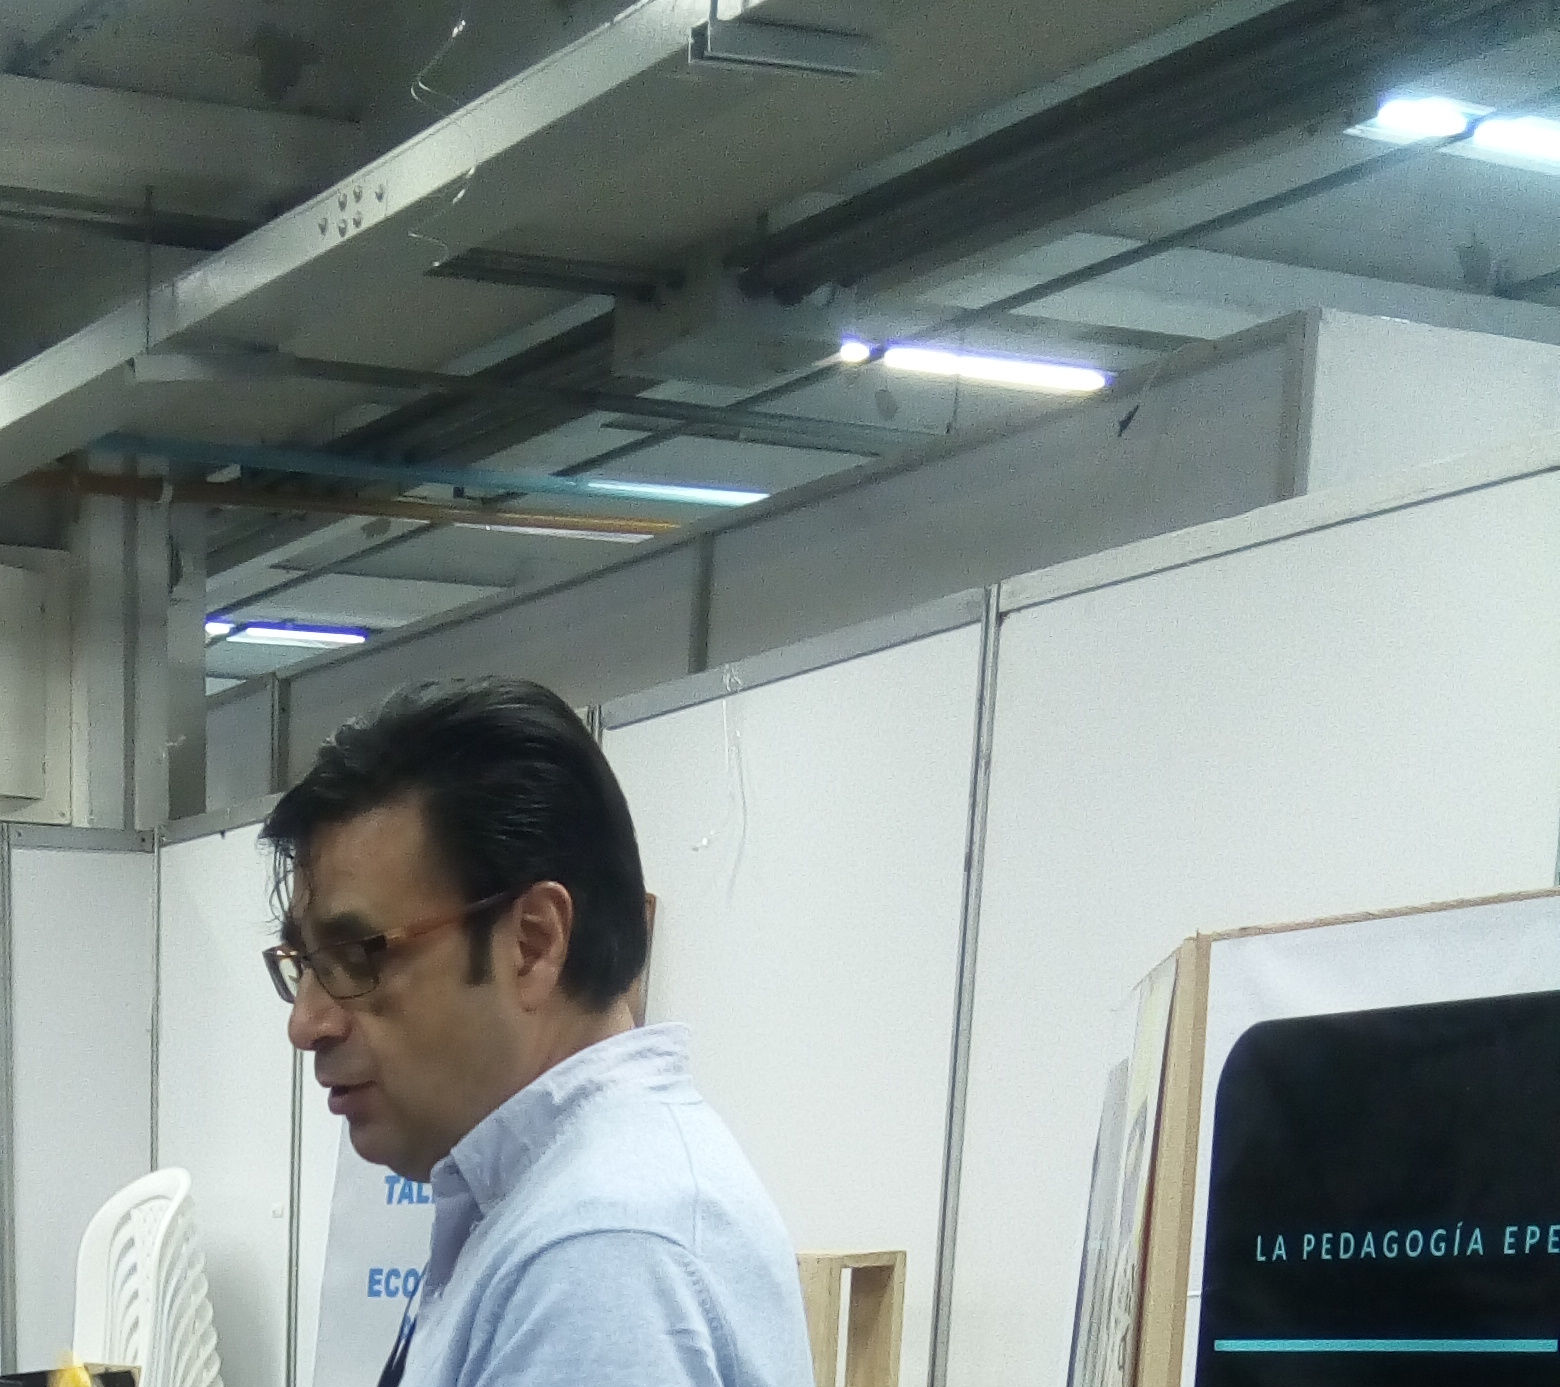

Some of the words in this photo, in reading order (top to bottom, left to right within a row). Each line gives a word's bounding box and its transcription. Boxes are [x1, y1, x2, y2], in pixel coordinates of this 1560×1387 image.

[1256, 1233, 1288, 1261] LA
[1303, 1221, 1484, 1260] PEDAGOGÍA
[1503, 1224, 1560, 1254] EPE
